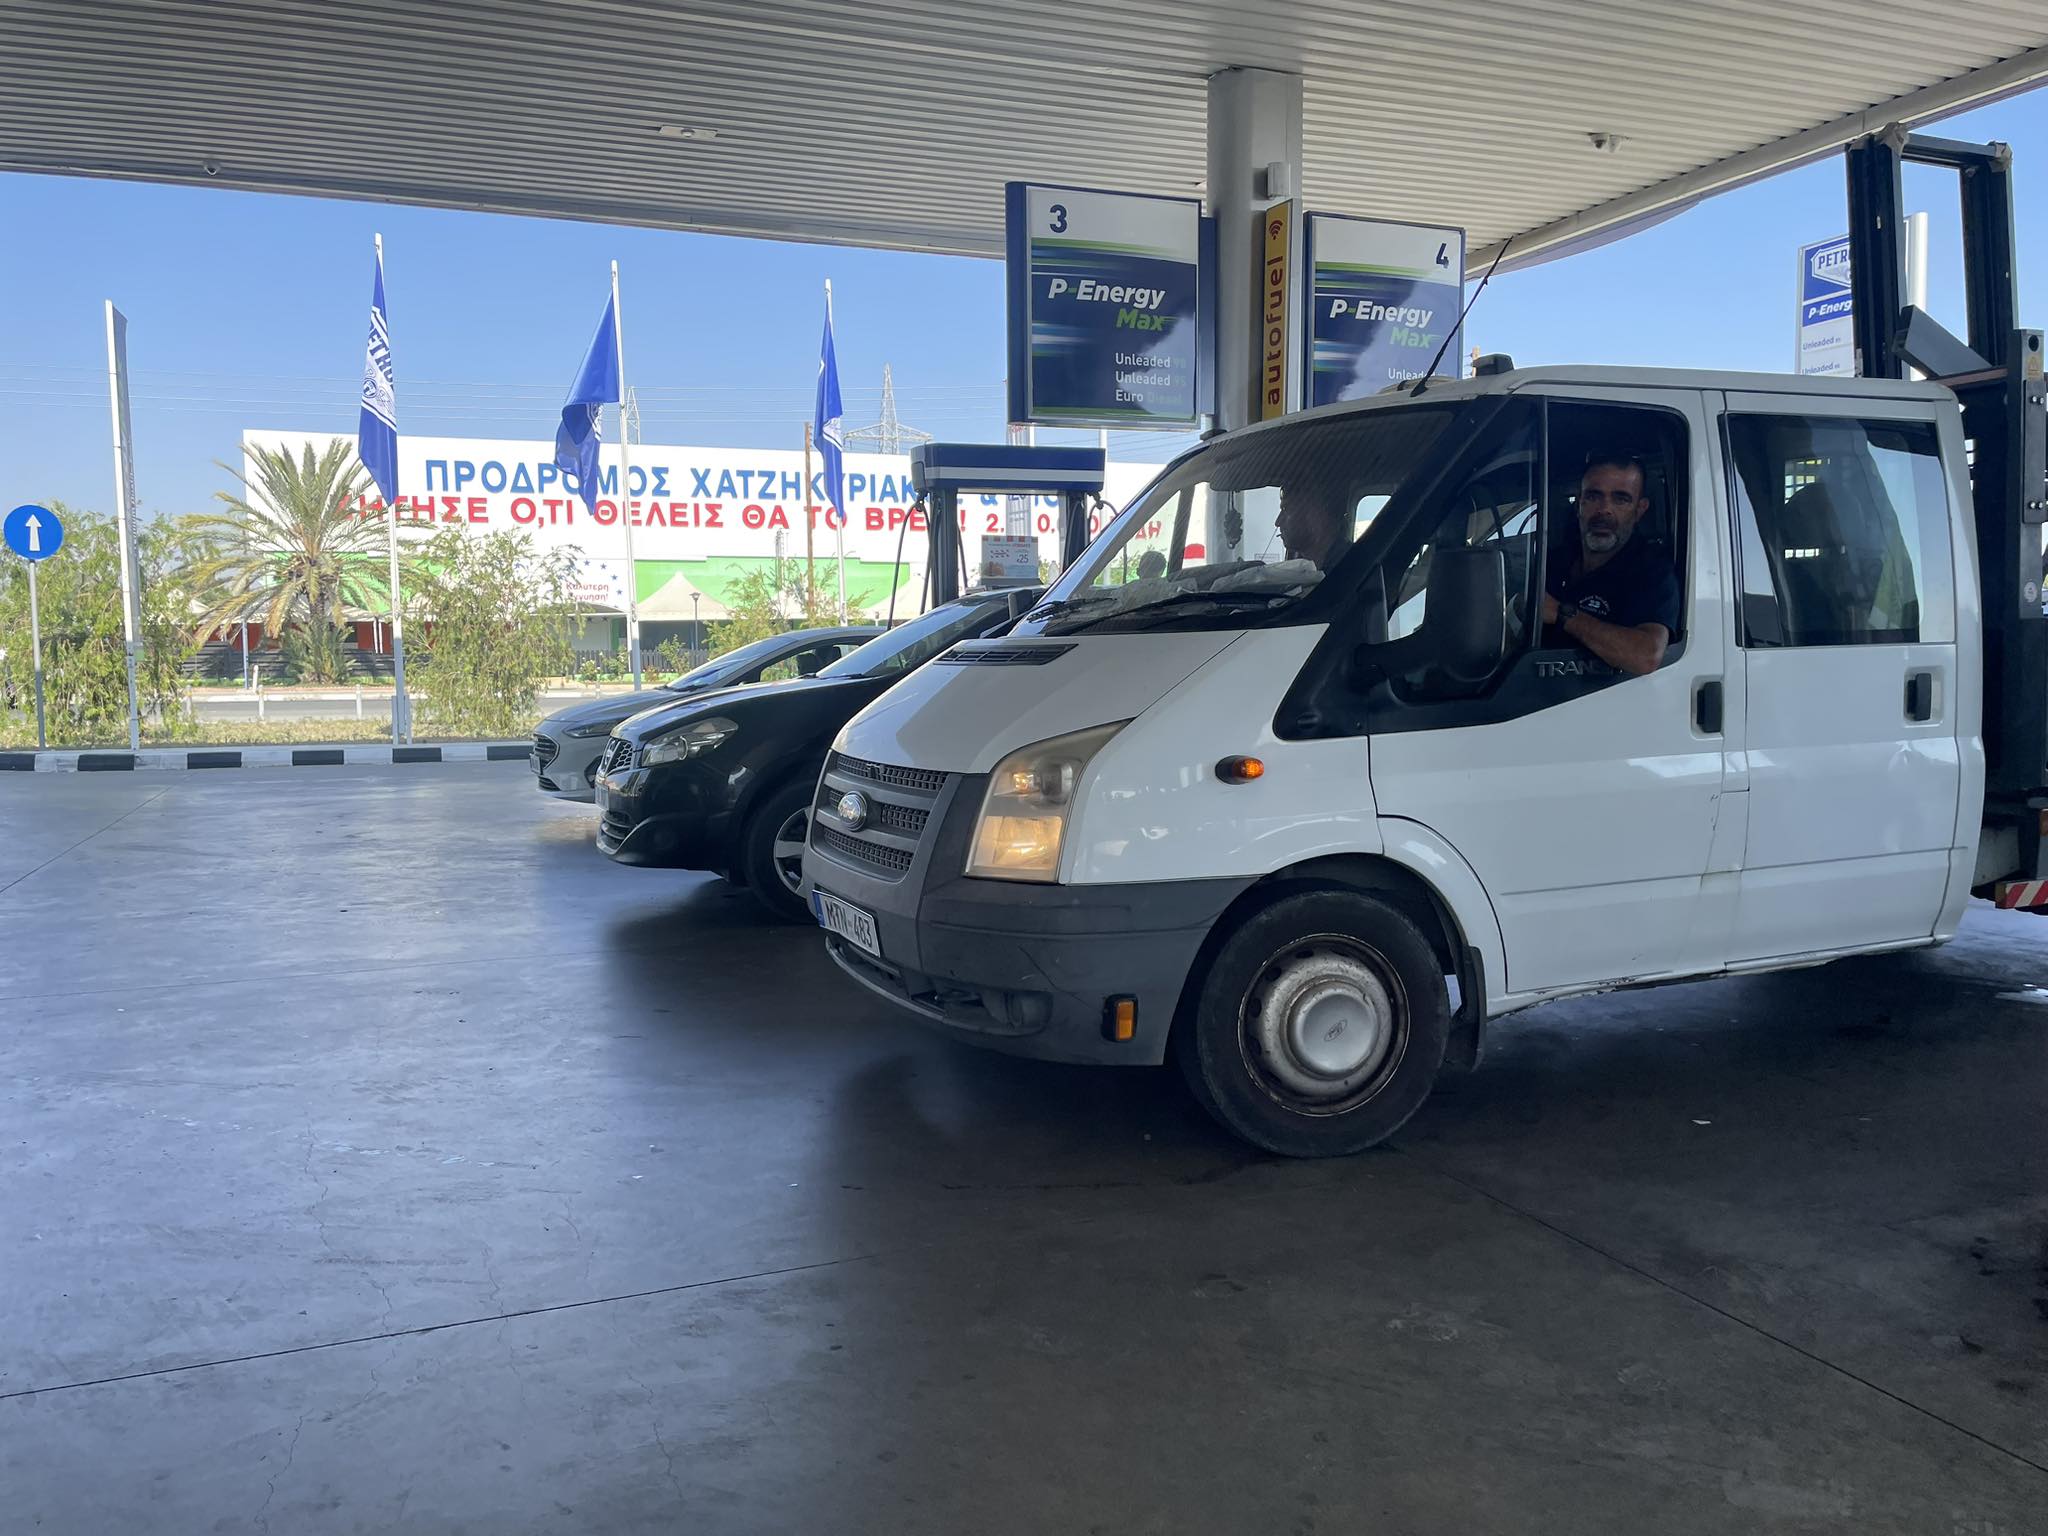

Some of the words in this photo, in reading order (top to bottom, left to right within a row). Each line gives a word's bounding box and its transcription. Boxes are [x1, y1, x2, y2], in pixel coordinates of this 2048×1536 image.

[1049, 204, 1068, 233] 3
[1435, 242, 1450, 269] 4
[1817, 249, 1850, 270] PETR
[1048, 278, 1166, 309] P-Energy
[1115, 308, 1168, 331] Max
[1329, 299, 1433, 328] P-Energy
[1808, 299, 1852, 319] P-Energ
[1266, 255, 1284, 406] autofuel
[1390, 327, 1434, 349] Max
[1803, 336, 1835, 351] Unleaded
[1115, 352, 1171, 368] Unleaded
[1115, 371, 1171, 386] Unleaded
[1388, 367, 1436, 380] Unlead
[1115, 389, 1144, 402] Euro
[594, 500, 724, 528] ΘΕΛΕΙΣ
[742, 504, 790, 530] ΘΑ
[804, 506, 847, 530] ΤΟ
[1535, 660, 1602, 678] TRAN
